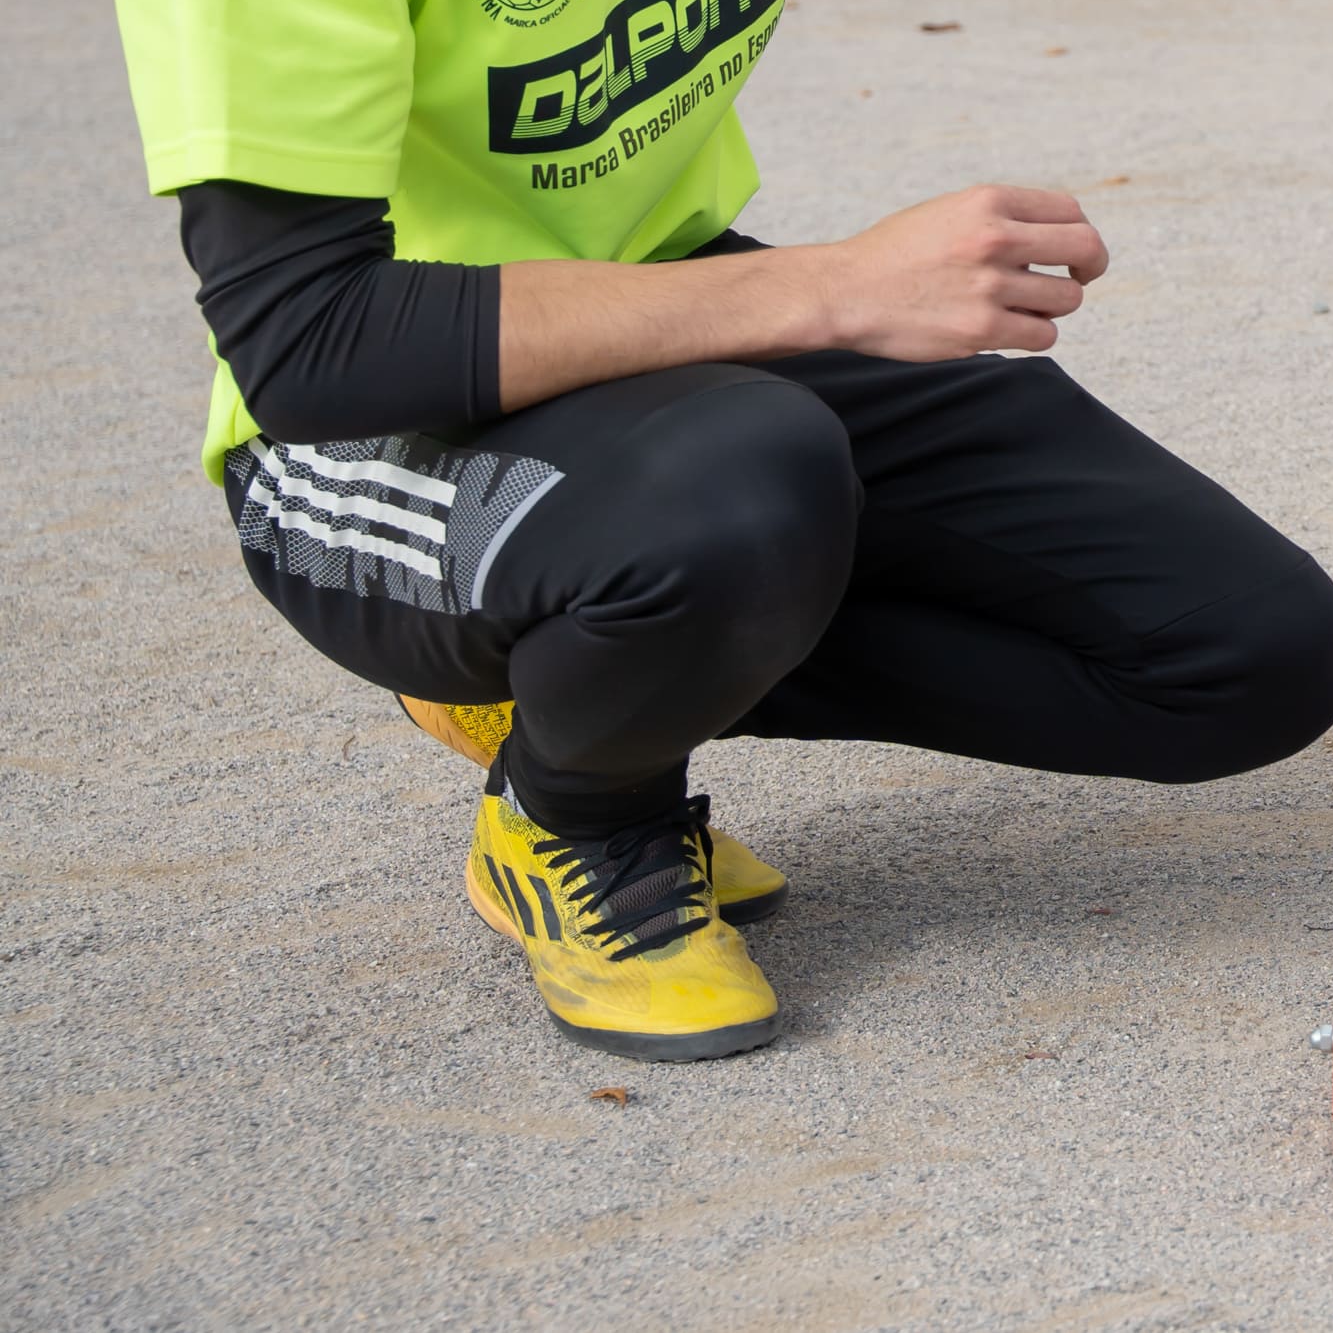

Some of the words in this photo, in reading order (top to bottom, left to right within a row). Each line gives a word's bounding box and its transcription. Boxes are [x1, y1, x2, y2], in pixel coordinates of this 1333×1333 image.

[504, 15, 537, 28] MARCA
[532, 146, 619, 190] Marca
[618, 73, 714, 160] Brasileira
[719, 52, 742, 86] no
